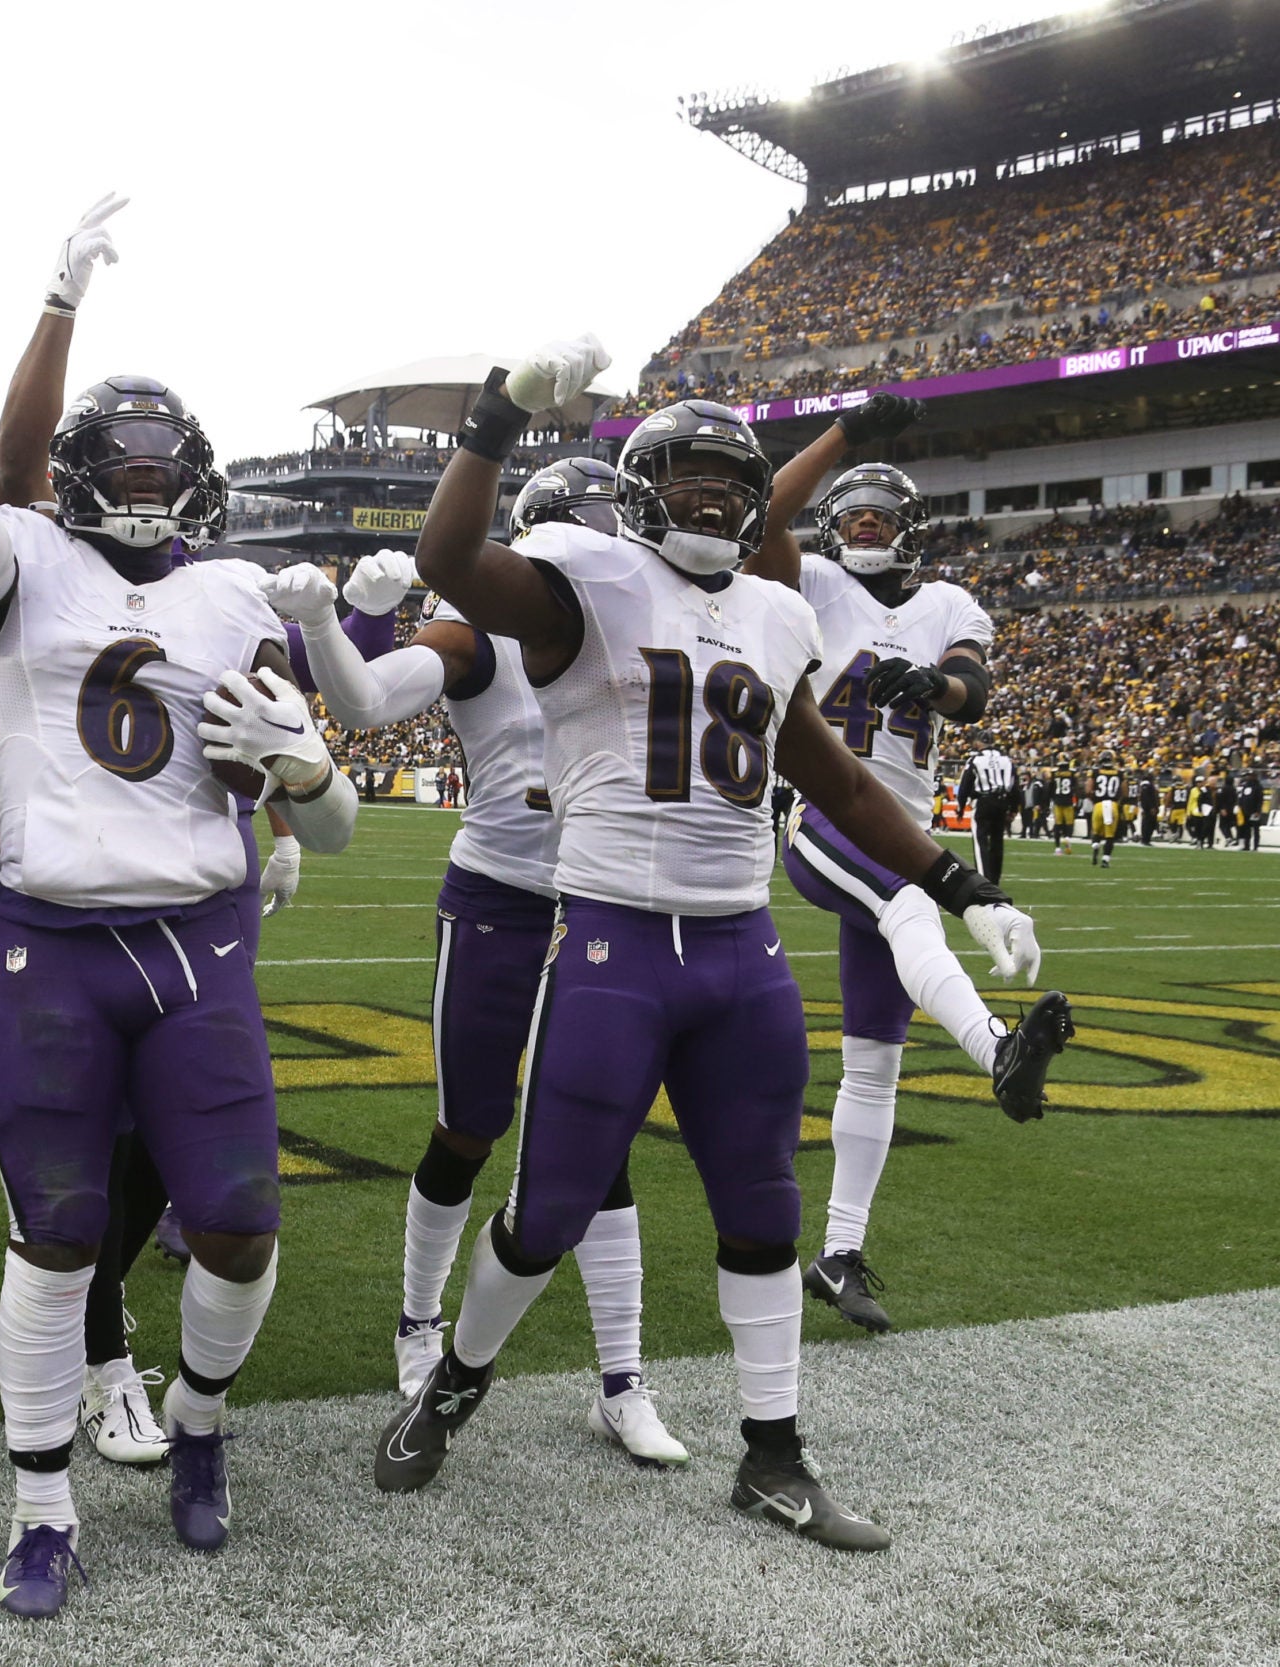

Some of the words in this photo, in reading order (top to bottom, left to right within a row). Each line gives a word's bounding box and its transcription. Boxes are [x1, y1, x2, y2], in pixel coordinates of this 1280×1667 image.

[1066, 351, 1120, 376] BRING
[1130, 346, 1148, 366] IT
[1177, 332, 1234, 358] UPMC
[757, 404, 770, 420] IT
[794, 394, 837, 416] UPMC
[107, 626, 161, 638] RAVENS
[696, 635, 743, 654] RAVENS
[872, 640, 908, 652] RAVENS
[77, 637, 174, 782] 6
[819, 649, 934, 770] 44
[638, 647, 775, 809] 18
[1055, 778, 1071, 795] 18
[1095, 775, 1120, 798] 30
